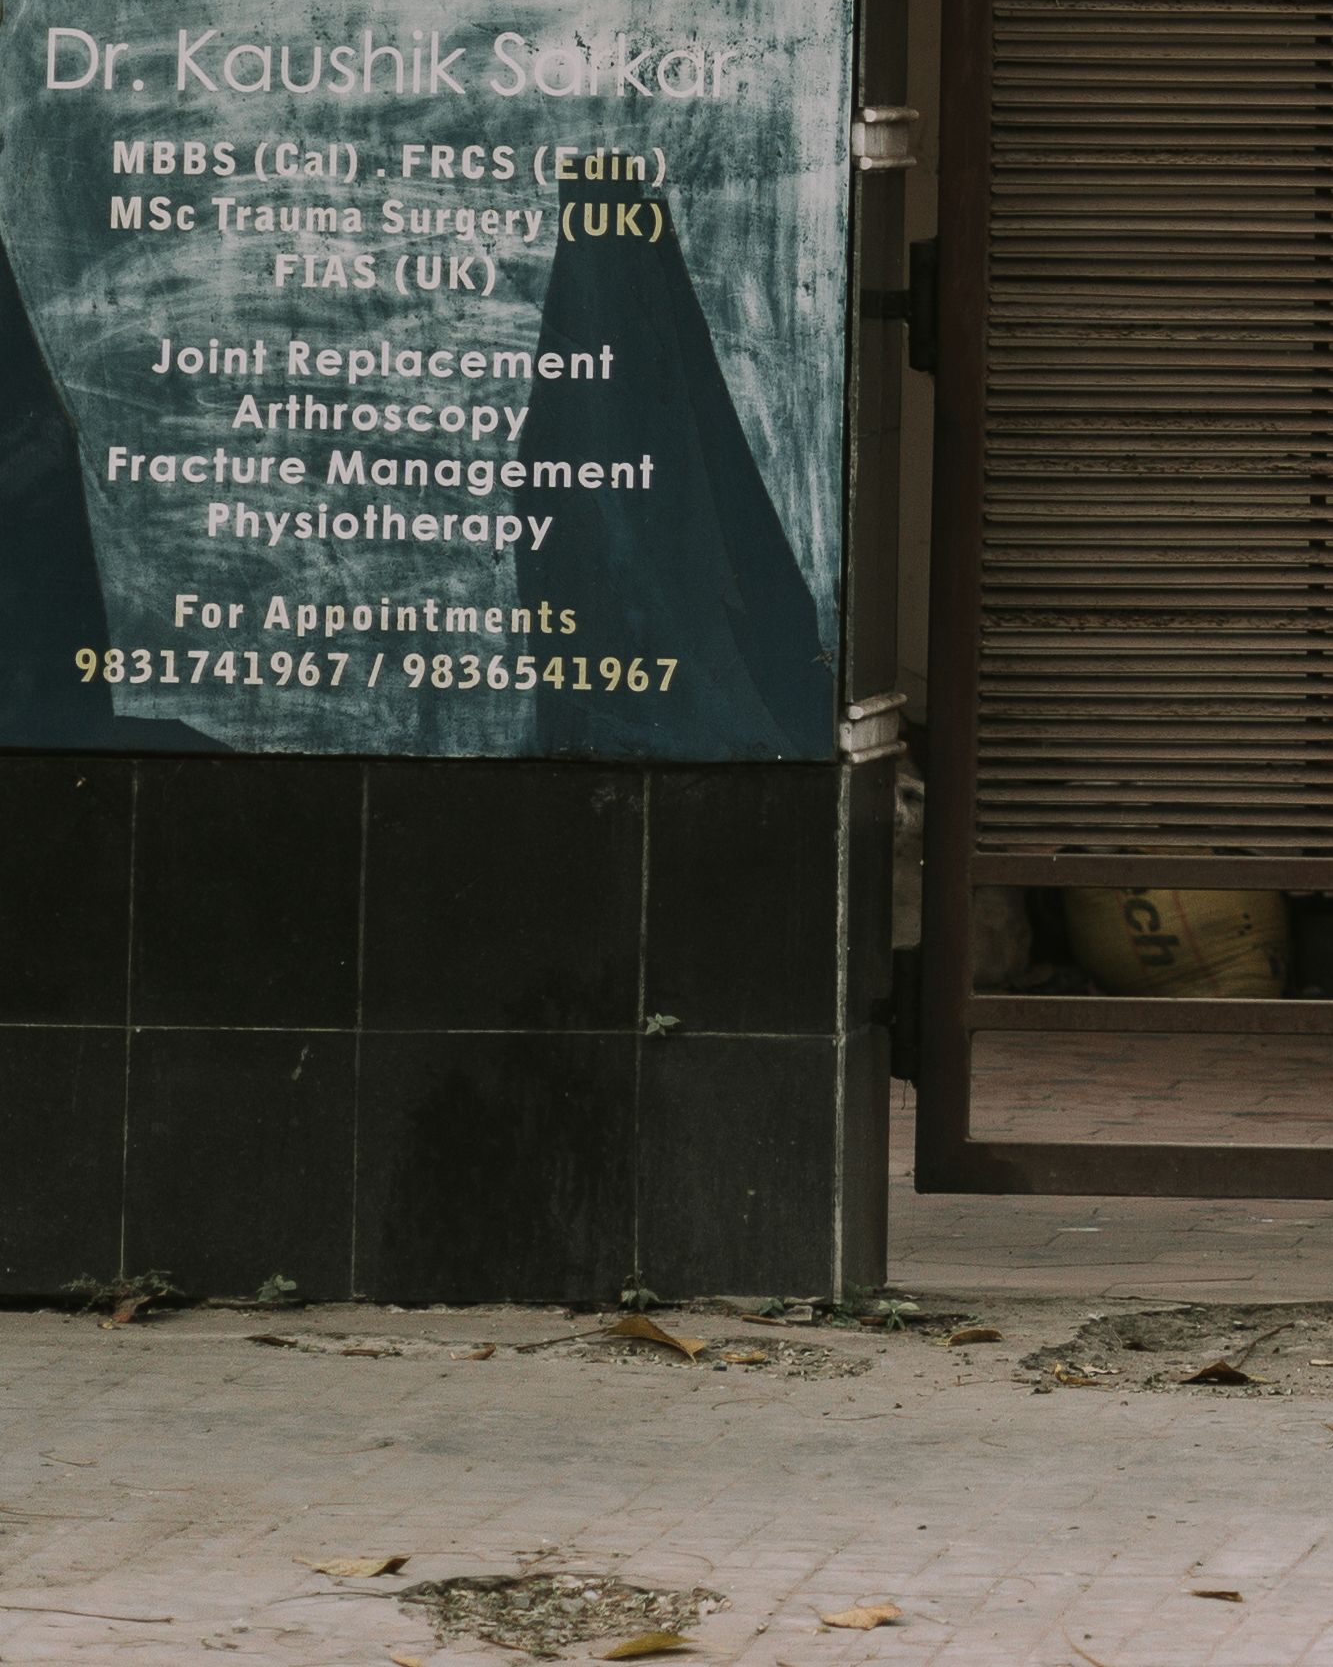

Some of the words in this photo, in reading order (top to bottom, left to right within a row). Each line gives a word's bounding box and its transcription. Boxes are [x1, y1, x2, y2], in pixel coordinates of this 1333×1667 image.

[46, 26, 145, 92] Dr.
[177, 28, 467, 95] Kaushik
[489, 30, 741, 98] Sarkar
[112, 140, 237, 177] MBBS
[254, 141, 359, 184] (Cal)
[402, 143, 516, 180] FRCS
[533, 145, 667, 188] (Edin)
[110, 195, 196, 232] MSc
[211, 196, 363, 234] Trauma
[382, 199, 544, 243] Surgery
[561, 201, 664, 243] (UK)
[274, 253, 377, 290] FIAS
[394, 254, 497, 297] (UK)
[151, 338, 268, 375] Joint
[287, 340, 614, 385] Replacement
[231, 394, 530, 442] Arthroscopy
[107, 446, 307, 484] Fracture
[326, 449, 654, 496] Management
[207, 501, 554, 551] Physiotherapy
[174, 593, 244, 629] For
[263, 595, 577, 638] Appointments
[75, 648, 350, 687] 9831741967
[402, 652, 679, 692] 9836541967
